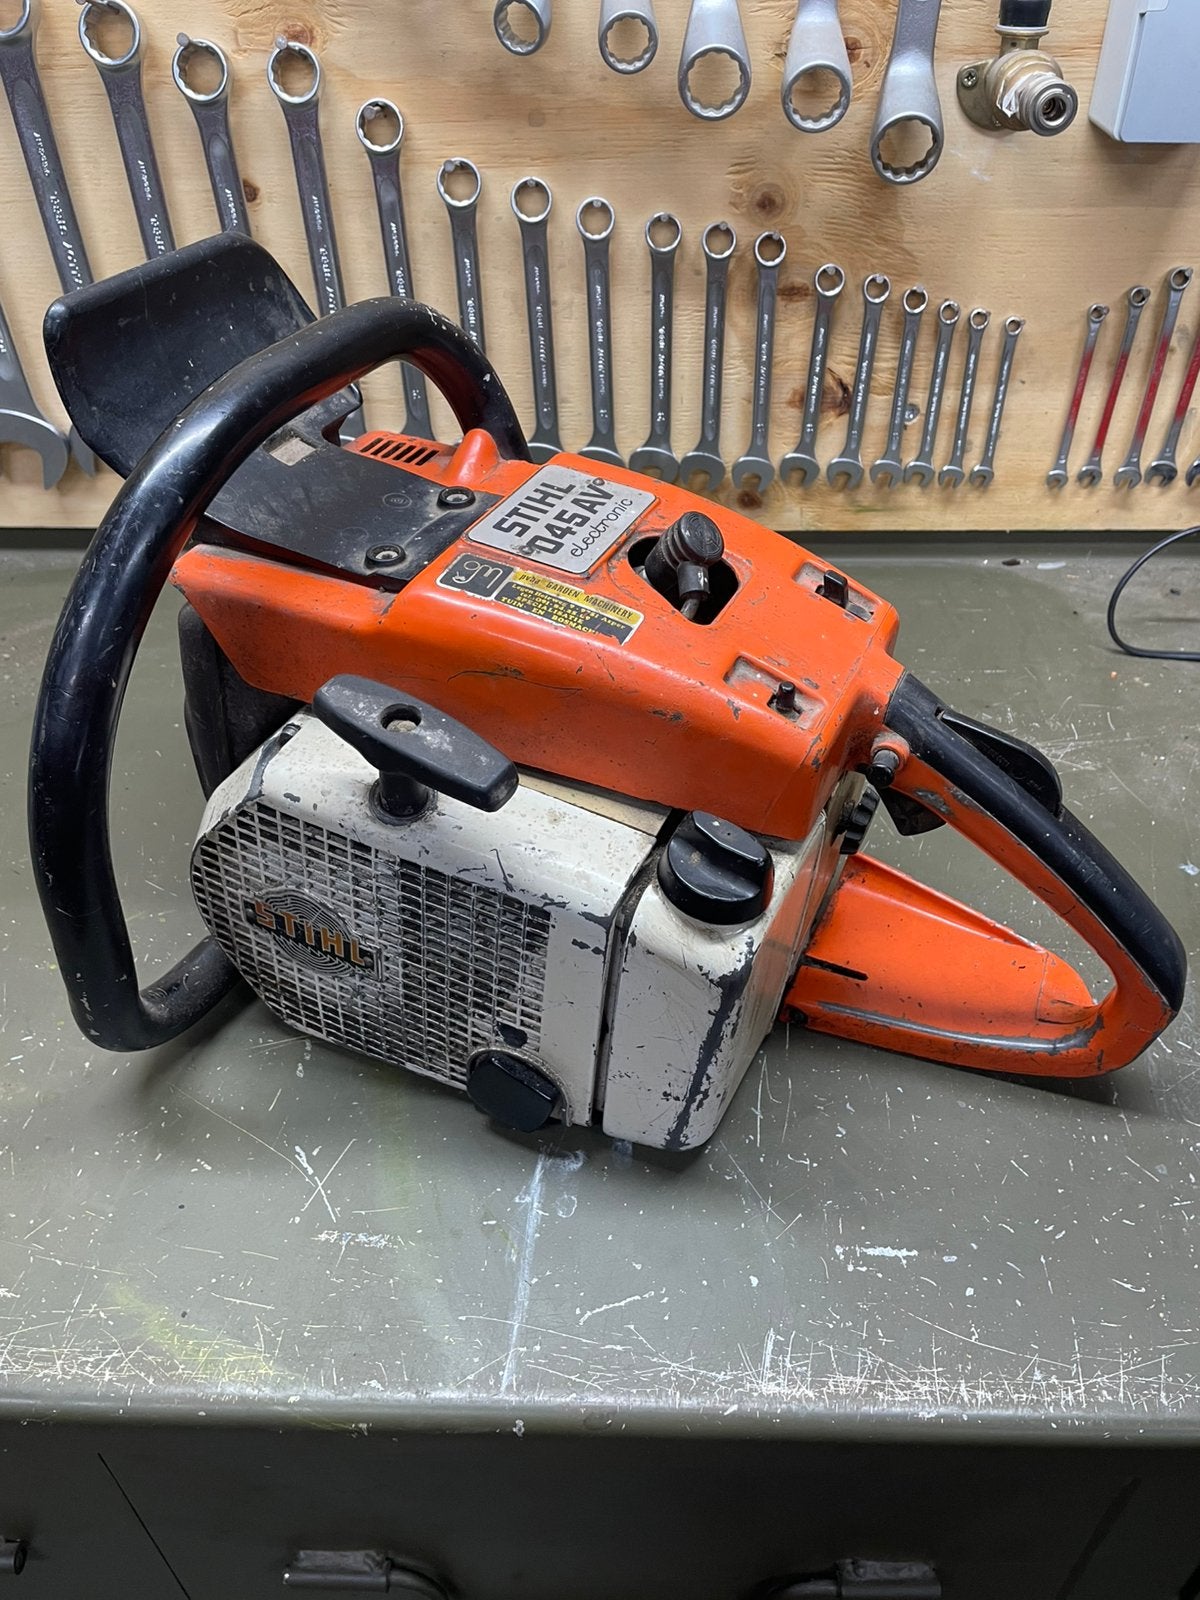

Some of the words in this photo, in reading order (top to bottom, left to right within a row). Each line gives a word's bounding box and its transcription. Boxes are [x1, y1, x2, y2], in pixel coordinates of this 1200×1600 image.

[492, 482, 576, 537] STIHL
[570, 498, 633, 557] electronic
[532, 607, 546, 616] EN
[546, 581, 580, 598] GARDEN
[583, 595, 633, 620] MACHINERY
[254, 900, 366, 967] STIHL
